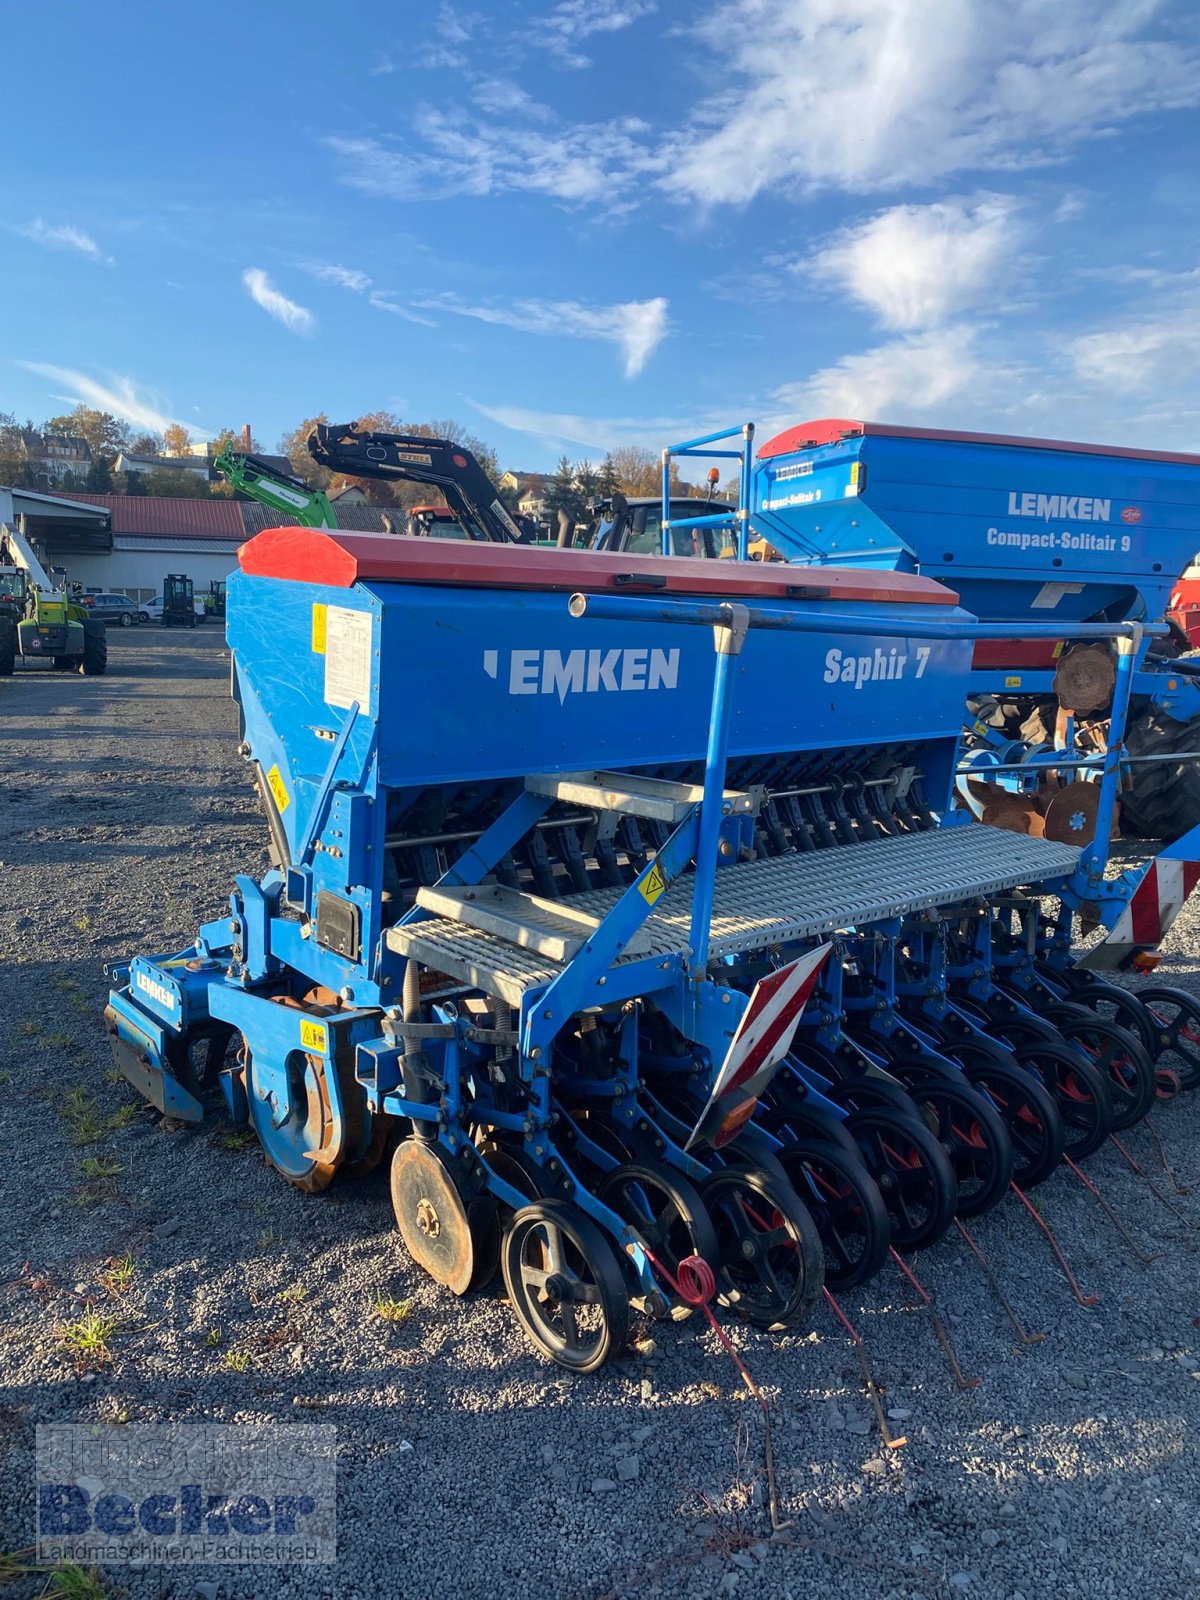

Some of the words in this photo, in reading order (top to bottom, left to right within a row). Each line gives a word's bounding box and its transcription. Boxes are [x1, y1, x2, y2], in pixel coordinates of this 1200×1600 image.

[775, 461, 814, 482] LEMKEN
[815, 488, 822, 501] 9
[1008, 491, 1111, 524] LEMKEN
[987, 527, 1117, 551] Compact-Solitair
[1121, 535, 1131, 552] 9
[823, 647, 908, 690] Saphir
[914, 647, 931, 679] 7
[137, 970, 175, 1012] LEMKEN
